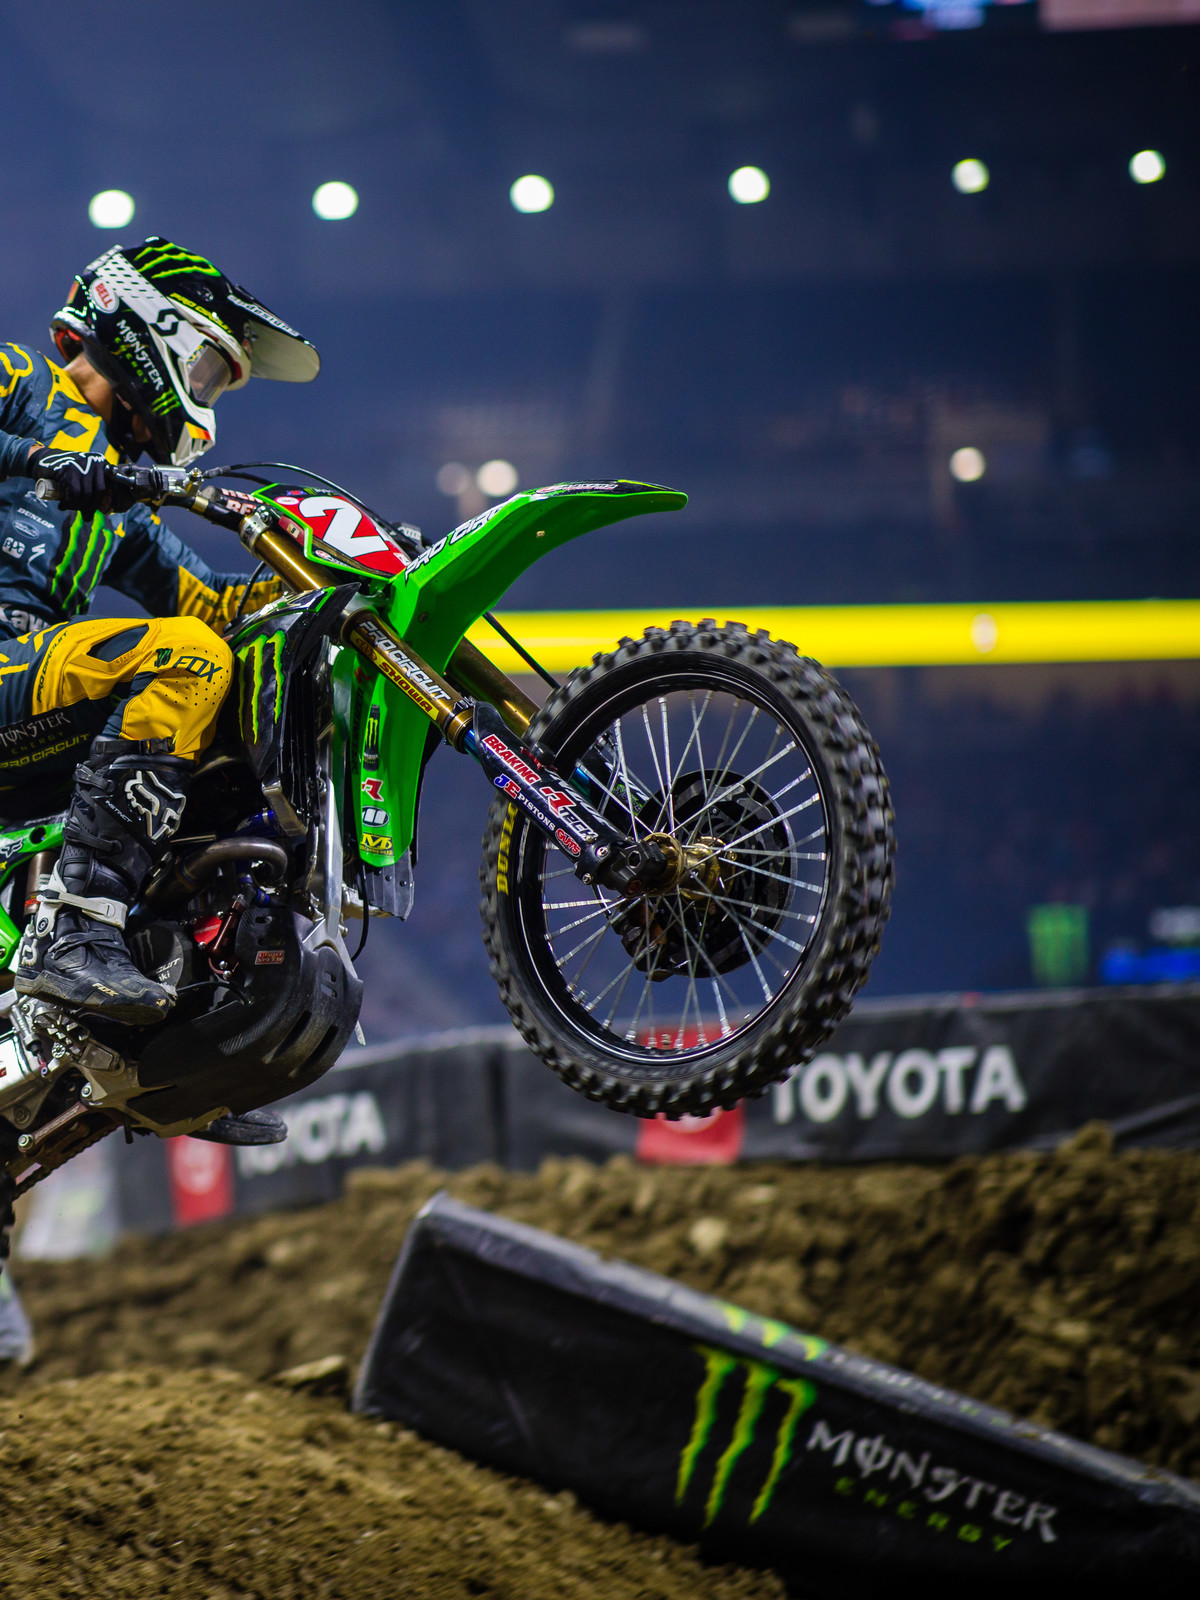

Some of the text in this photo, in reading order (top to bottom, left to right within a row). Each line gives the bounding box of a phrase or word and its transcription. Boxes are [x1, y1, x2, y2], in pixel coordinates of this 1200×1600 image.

[95, 283, 112, 308] BELL
[17, 507, 55, 529] DUNLOP
[4, 539, 26, 556] PPG
[172, 656, 223, 683] FOX
[360, 621, 397, 651] PRO
[387, 649, 451, 701] CIRCUIT
[380, 661, 433, 713] SHOWA
[0, 733, 90, 769] PRO CIRCUIT
[483, 734, 542, 785] BRAKING
[105, 800, 133, 823] INSTINCT
[493, 774, 521, 800] JE
[517, 792, 556, 832] PISTONS
[555, 828, 581, 855] GUTS
[92, 983, 119, 997] FOX
